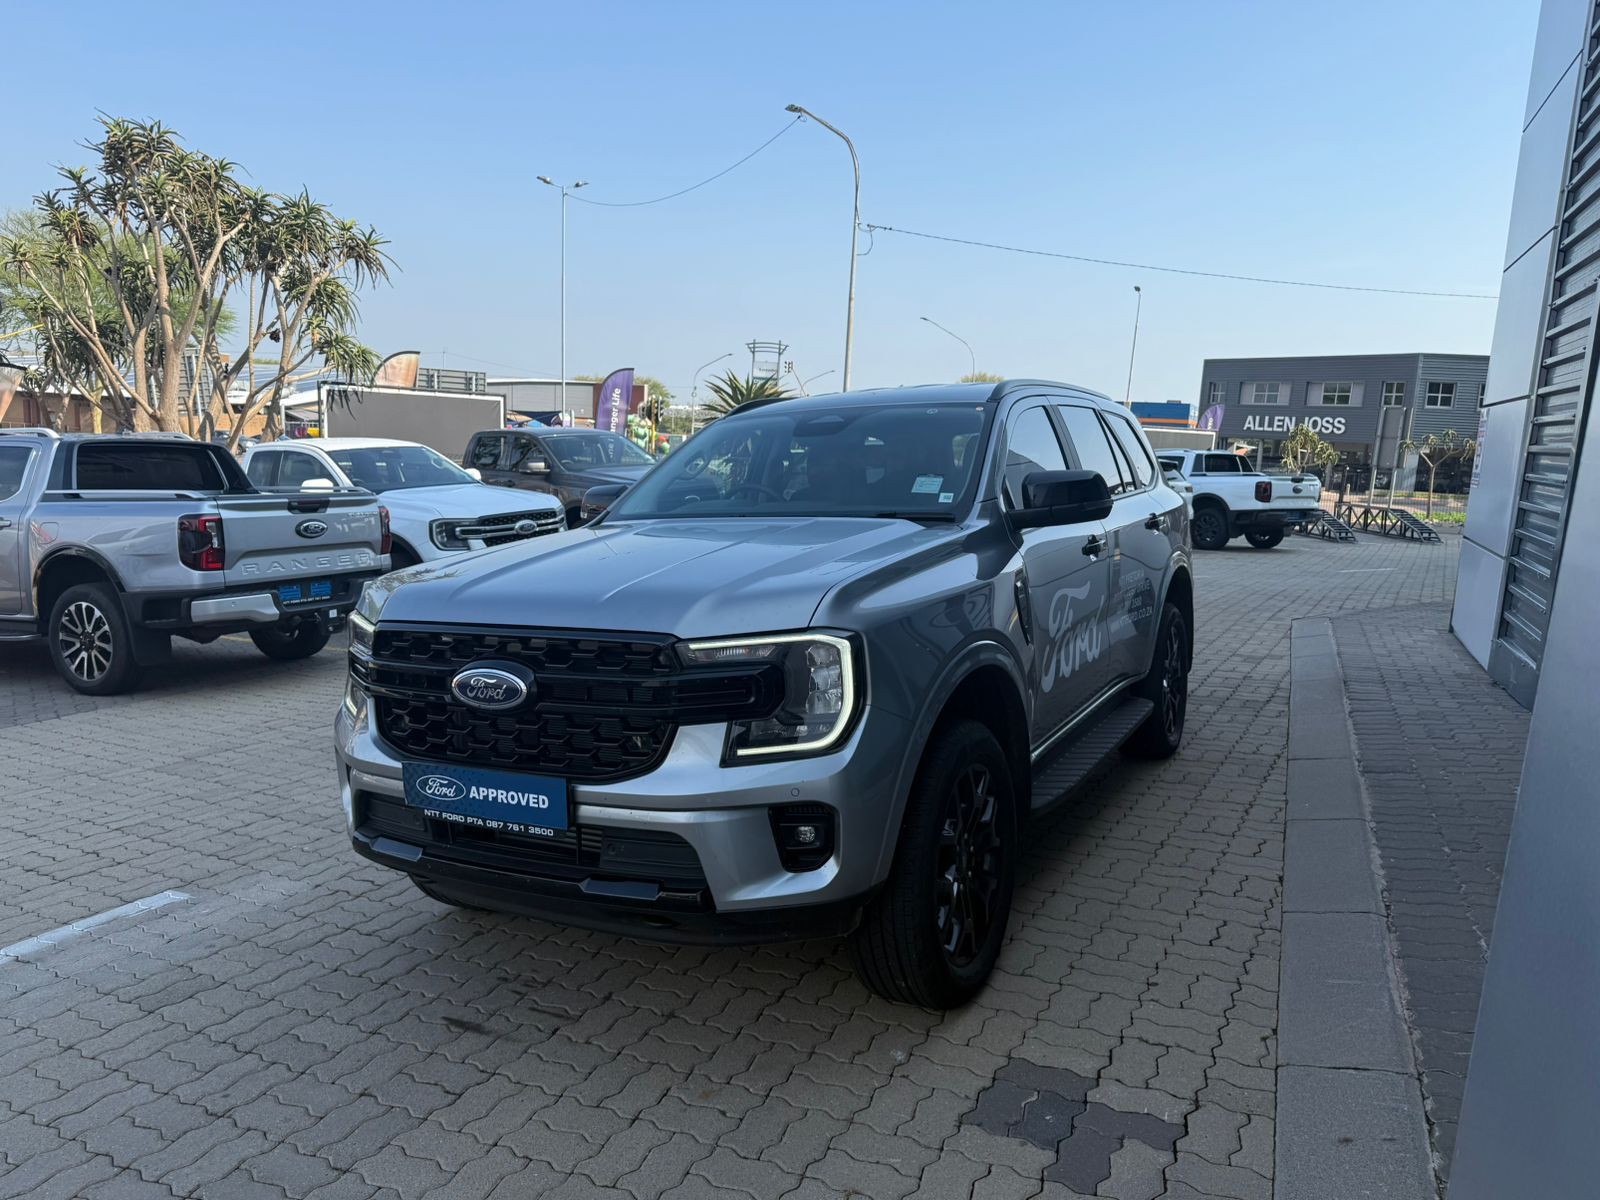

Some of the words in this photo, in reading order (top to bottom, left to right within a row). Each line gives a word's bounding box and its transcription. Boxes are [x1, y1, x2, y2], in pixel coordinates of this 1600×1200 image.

[611, 388, 622, 406] Life
[1243, 415, 1296, 432] ALLEN
[241, 552, 375, 576] RANGER
[1041, 580, 1105, 693] Ford
[466, 676, 508, 701] Ford
[425, 777, 457, 798] Ford
[468, 785, 549, 809] APPROVED
[424, 808, 440, 818] NTT
[442, 812, 465, 823] FORD
[467, 816, 484, 826] PTA
[506, 822, 525, 832] 761
[528, 826, 554, 837] 3500
